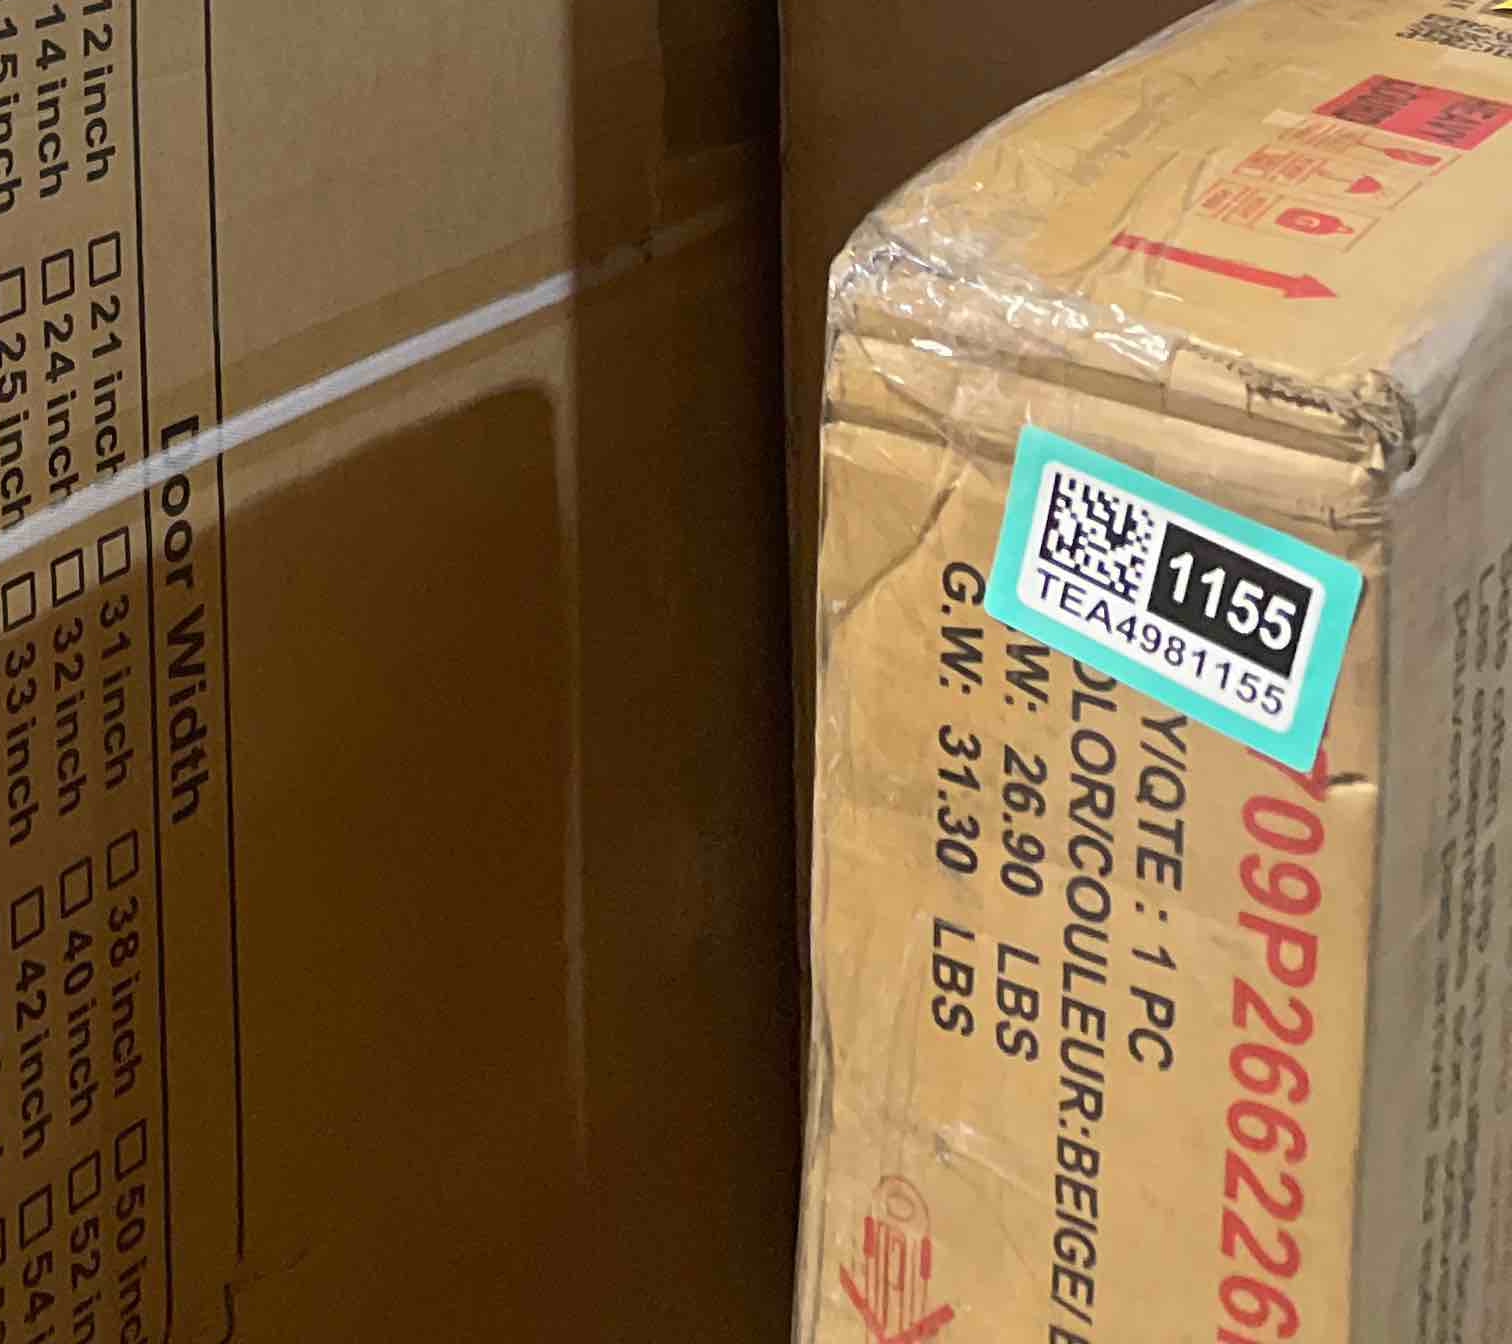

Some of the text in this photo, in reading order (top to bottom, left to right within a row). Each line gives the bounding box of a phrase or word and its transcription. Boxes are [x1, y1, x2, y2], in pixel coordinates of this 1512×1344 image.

[34, 3, 69, 199] 14 inch
[82, 64, 116, 183] inch
[43, 313, 75, 384] 24
[90, 294, 122, 359] 21
[1035, 568, 1286, 716] TEA4981155
[1167, 551, 1298, 650] 1155
[99, 594, 134, 791] 31 inch
[166, 603, 210, 825] Width
[931, 561, 985, 1037] G.W: 31.30 LBS
[999, 745, 1049, 897] 26.90
[107, 895, 143, 1099] 38 inch
[994, 943, 1040, 1062] LBS
[1130, 944, 1177, 970] 1
[62, 929, 98, 1127] 40 inch
[1127, 987, 1176, 1072] PC
[68, 1216, 100, 1291] 52
[114, 1184, 145, 1253] 50
[22, 1250, 54, 1323] 54
